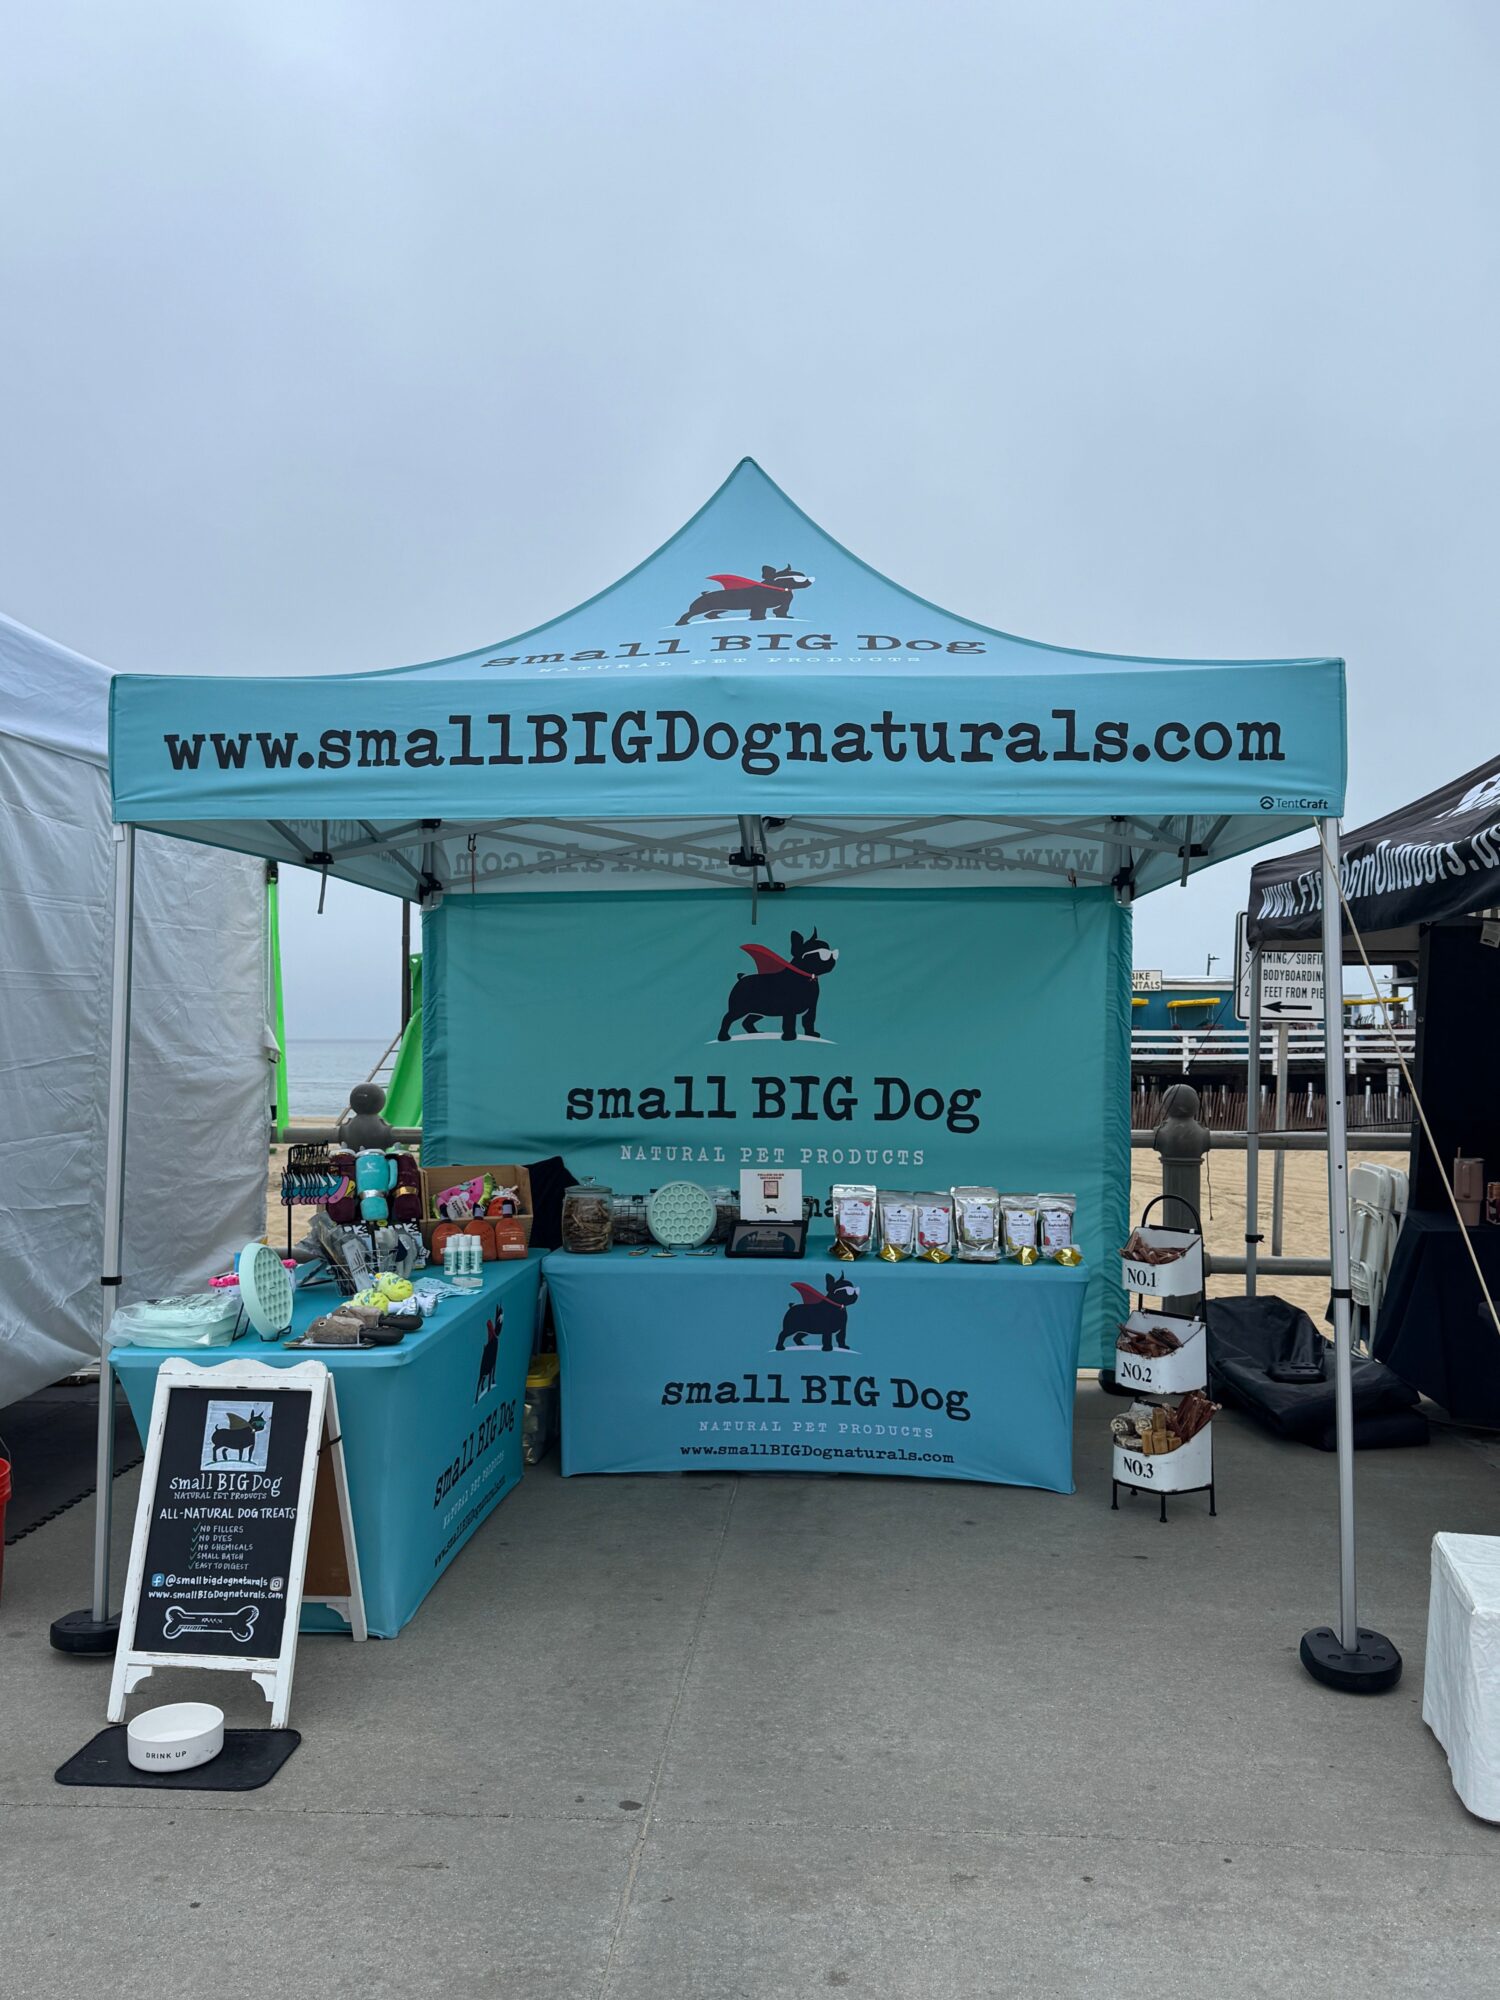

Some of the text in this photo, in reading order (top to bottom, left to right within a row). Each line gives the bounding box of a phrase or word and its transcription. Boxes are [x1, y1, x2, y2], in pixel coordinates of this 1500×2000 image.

[481, 633, 987, 668] small BIG Dog
[538, 661, 672, 673] NATURAL
[164, 709, 1286, 776] www.smallBIGDognaturals.com
[1276, 797, 1329, 810] TentCraft
[1263, 969, 1324, 982] BODYBOARDIN
[1264, 986, 1283, 998] FEET
[1285, 986, 1308, 999] FROM
[1311, 987, 1324, 999] PIE
[566, 1075, 982, 1135] small BIG Dog
[620, 1145, 926, 1166] NATURAL PET PRODUCTS
[1127, 1266, 1158, 1288] NO.1
[1122, 1361, 1153, 1384] NO.2
[661, 1373, 972, 1422] small BIG Dog
[699, 1420, 935, 1439] NATURAL PET PRODUCTS
[433, 1399, 516, 1510] small BIG Dog
[680, 1442, 955, 1465] www.smallBIGDognaturals.com
[1123, 1455, 1155, 1479] NO.3
[169, 1472, 283, 1498] small BIG Dog
[173, 1491, 212, 1500] NATURAL
[213, 1491, 229, 1500] PET
[159, 1506, 297, 1520] ALL-NATURAL DOG TREATS
[199, 1525, 244, 1534] NO FILLERS
[198, 1534, 233, 1542] NO DYES
[197, 1543, 254, 1551] NO CHEMICALS
[196, 1552, 244, 1561] SMALL BATCH
[194, 1561, 213, 1570] EASY
[223, 1562, 250, 1571] DIGEST
[148, 1588, 284, 1601] www.smallBIGDognaturals.com
[145, 1750, 187, 1759] DRINK UP
